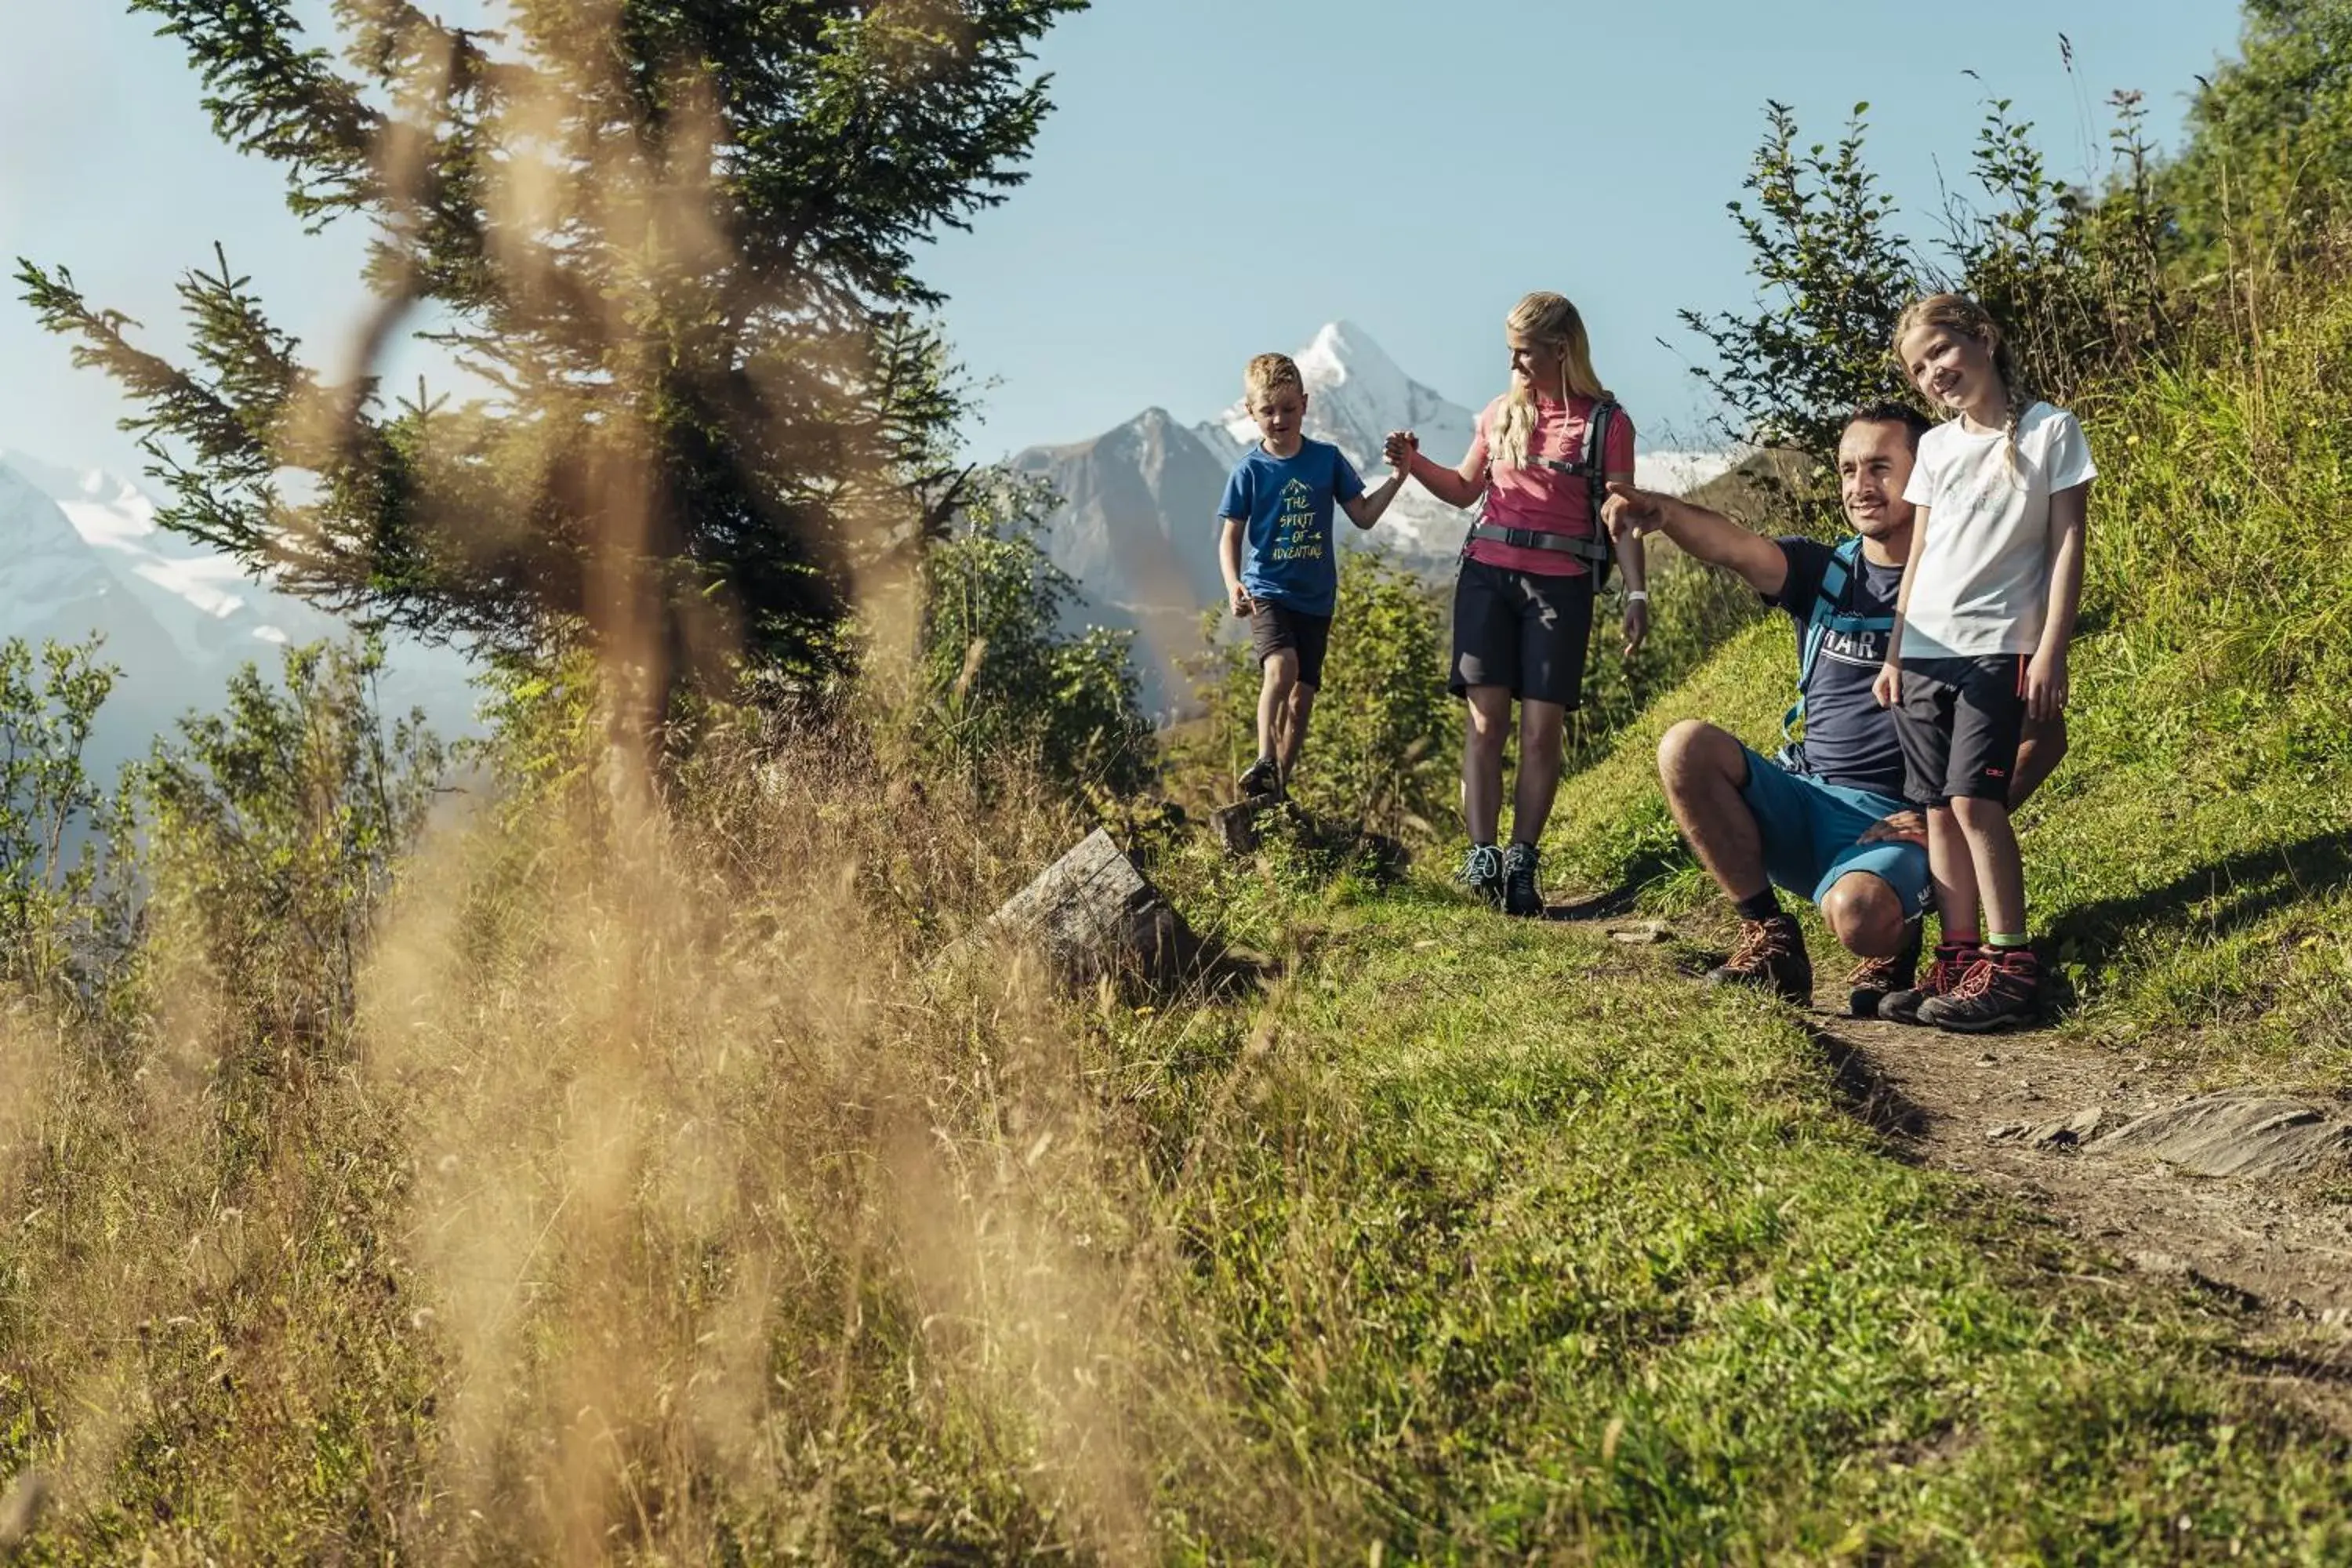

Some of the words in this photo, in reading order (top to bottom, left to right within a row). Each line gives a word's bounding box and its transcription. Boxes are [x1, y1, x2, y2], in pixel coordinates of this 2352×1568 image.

[1283, 495, 1310, 512] THE
[1279, 512, 1316, 528] SPIRIT
[1292, 529, 1308, 543] OF
